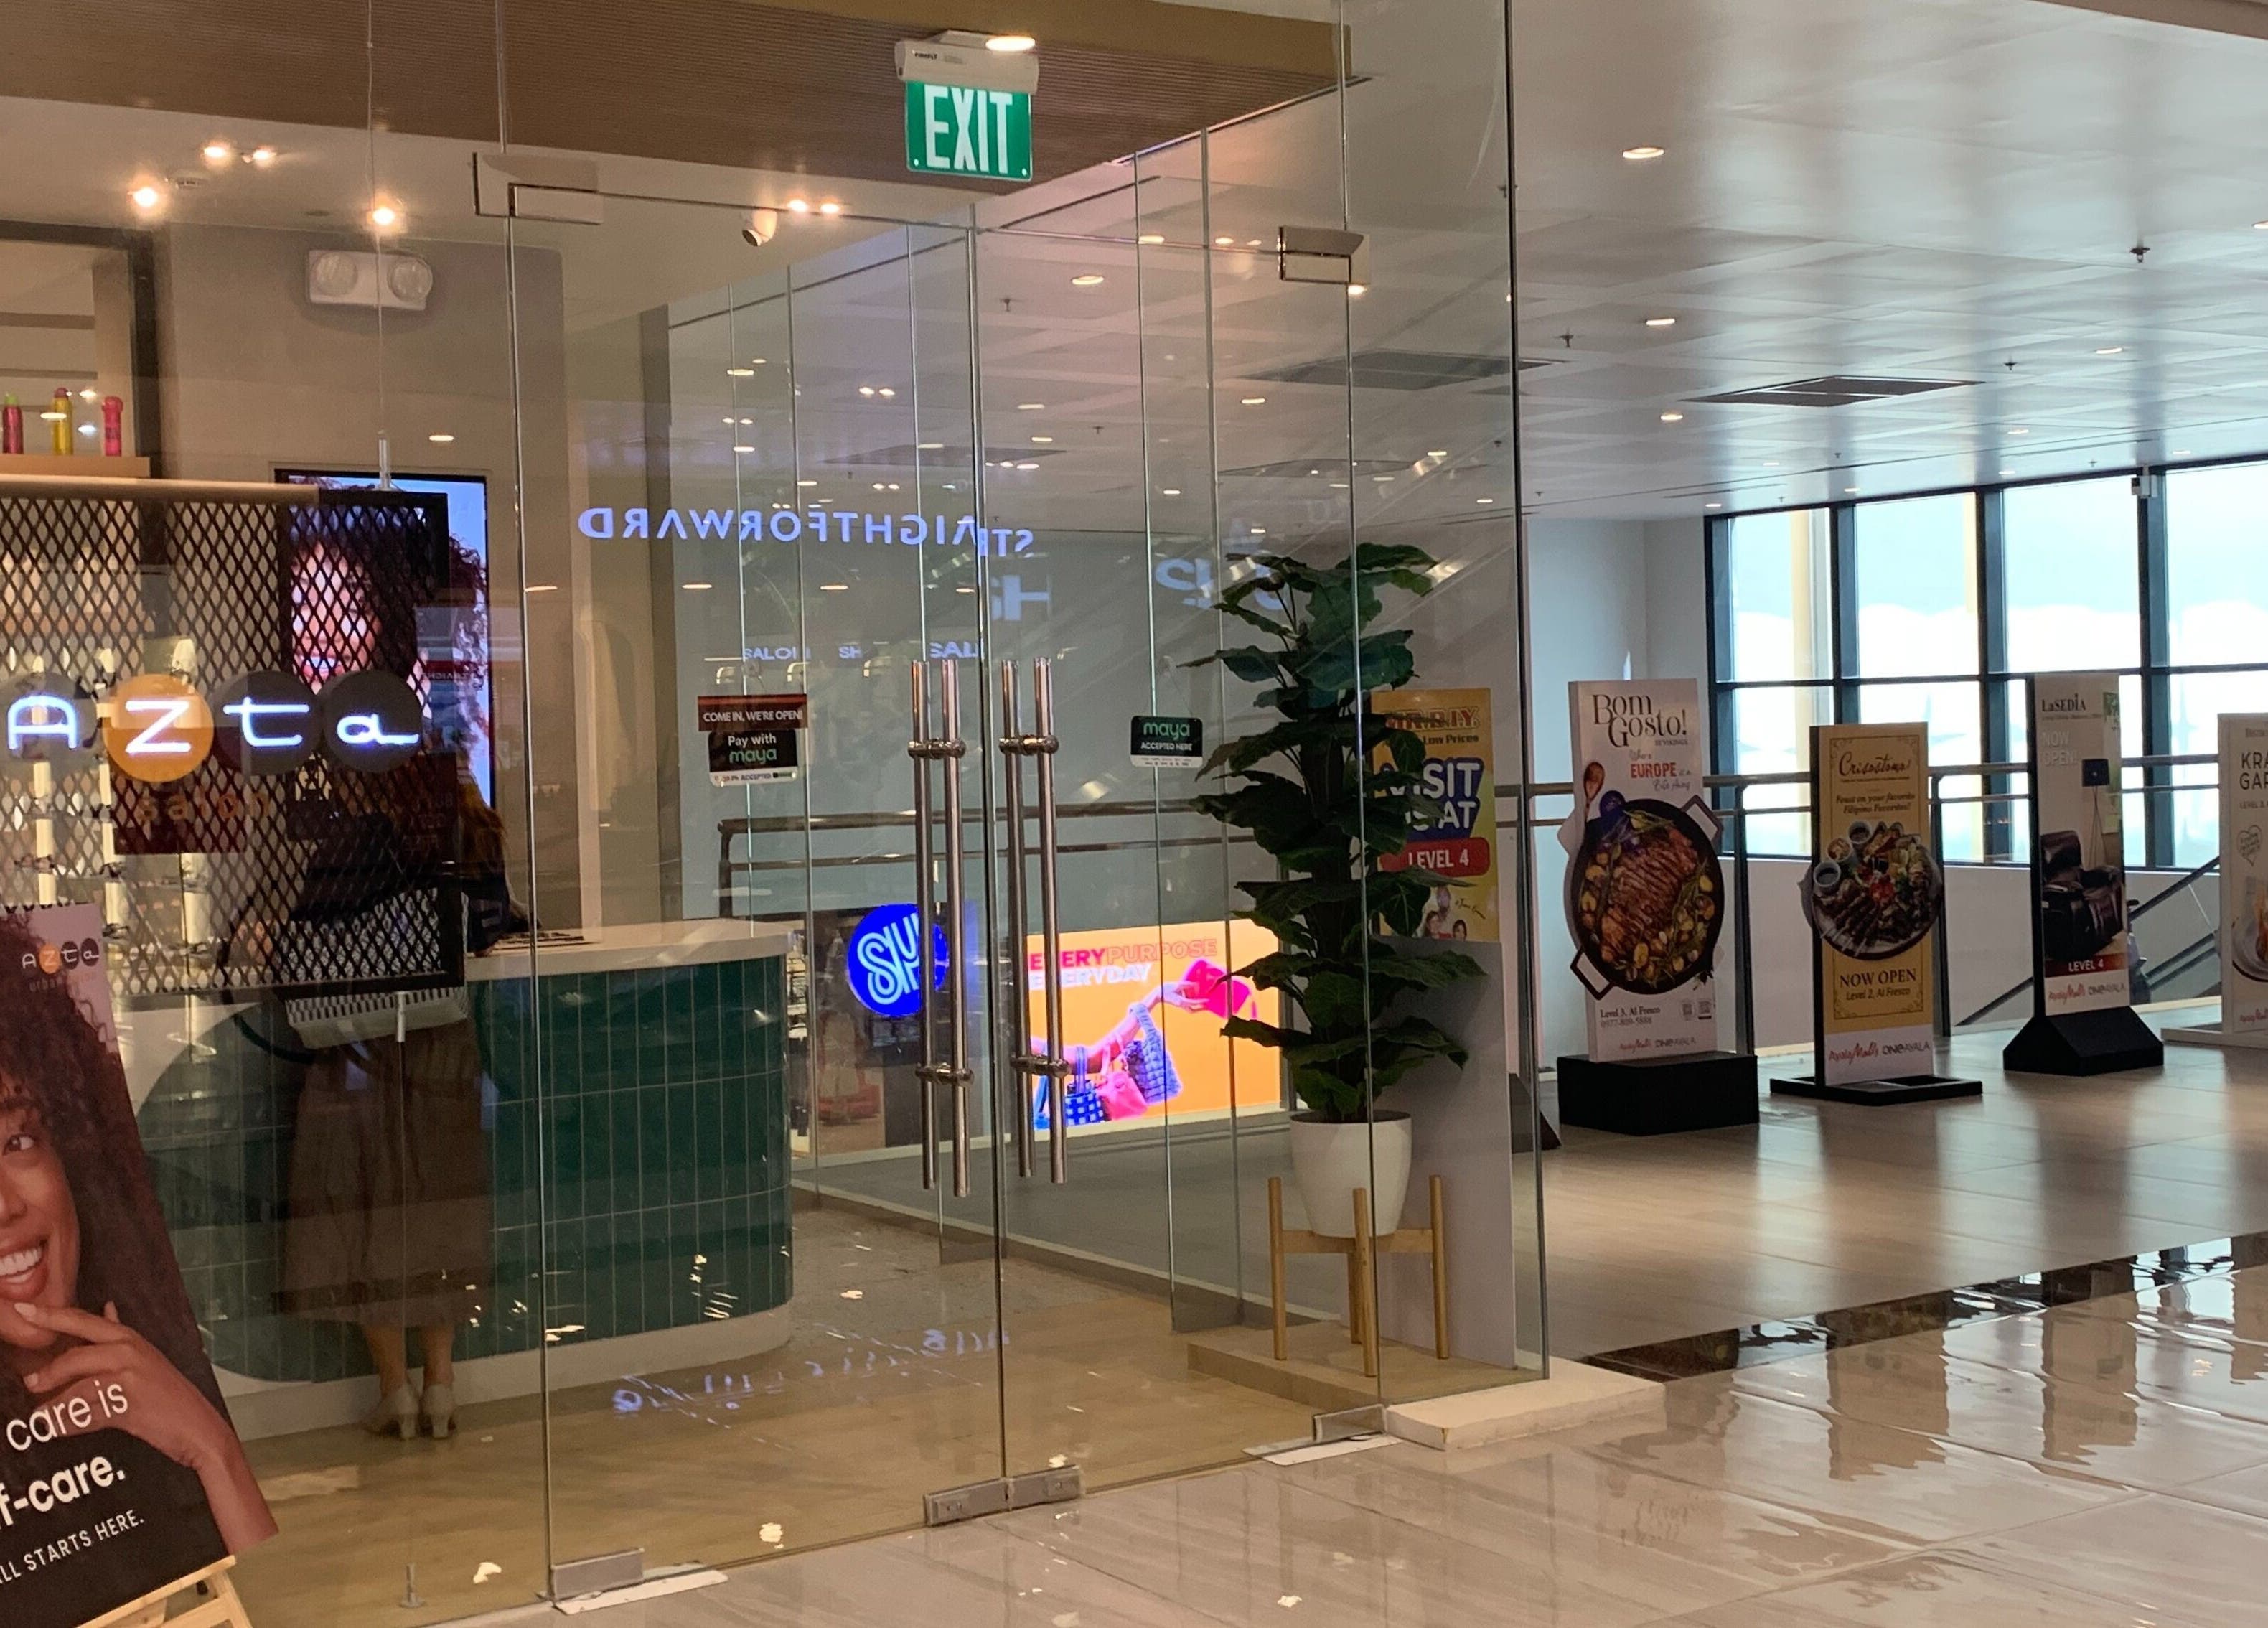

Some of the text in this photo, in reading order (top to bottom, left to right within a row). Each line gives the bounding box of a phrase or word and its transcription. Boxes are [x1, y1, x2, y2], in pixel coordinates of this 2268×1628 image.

[924, 84, 1013, 174] EXIT
[703, 711, 731, 722] COME
[1593, 694, 1651, 725] Bom
[1143, 722, 1190, 740] maya
[1608, 709, 1687, 748] Gosto!
[728, 733, 777, 748] Pay with
[729, 748, 777, 764] maya
[1631, 762, 1677, 779] EUROPE
[1408, 849, 1470, 869] LEVEL 4
[2068, 958, 2104, 972] LEVEL 4
[1029, 963, 1152, 990] EERYDAY
[1840, 969, 1916, 988] NOW OPEN
[1846, 991, 1866, 1000] Level
[1887, 988, 1911, 996] Fresco
[6, 1380, 128, 1451] care is
[0, 1510, 144, 1585] LL STARTS HERE.
